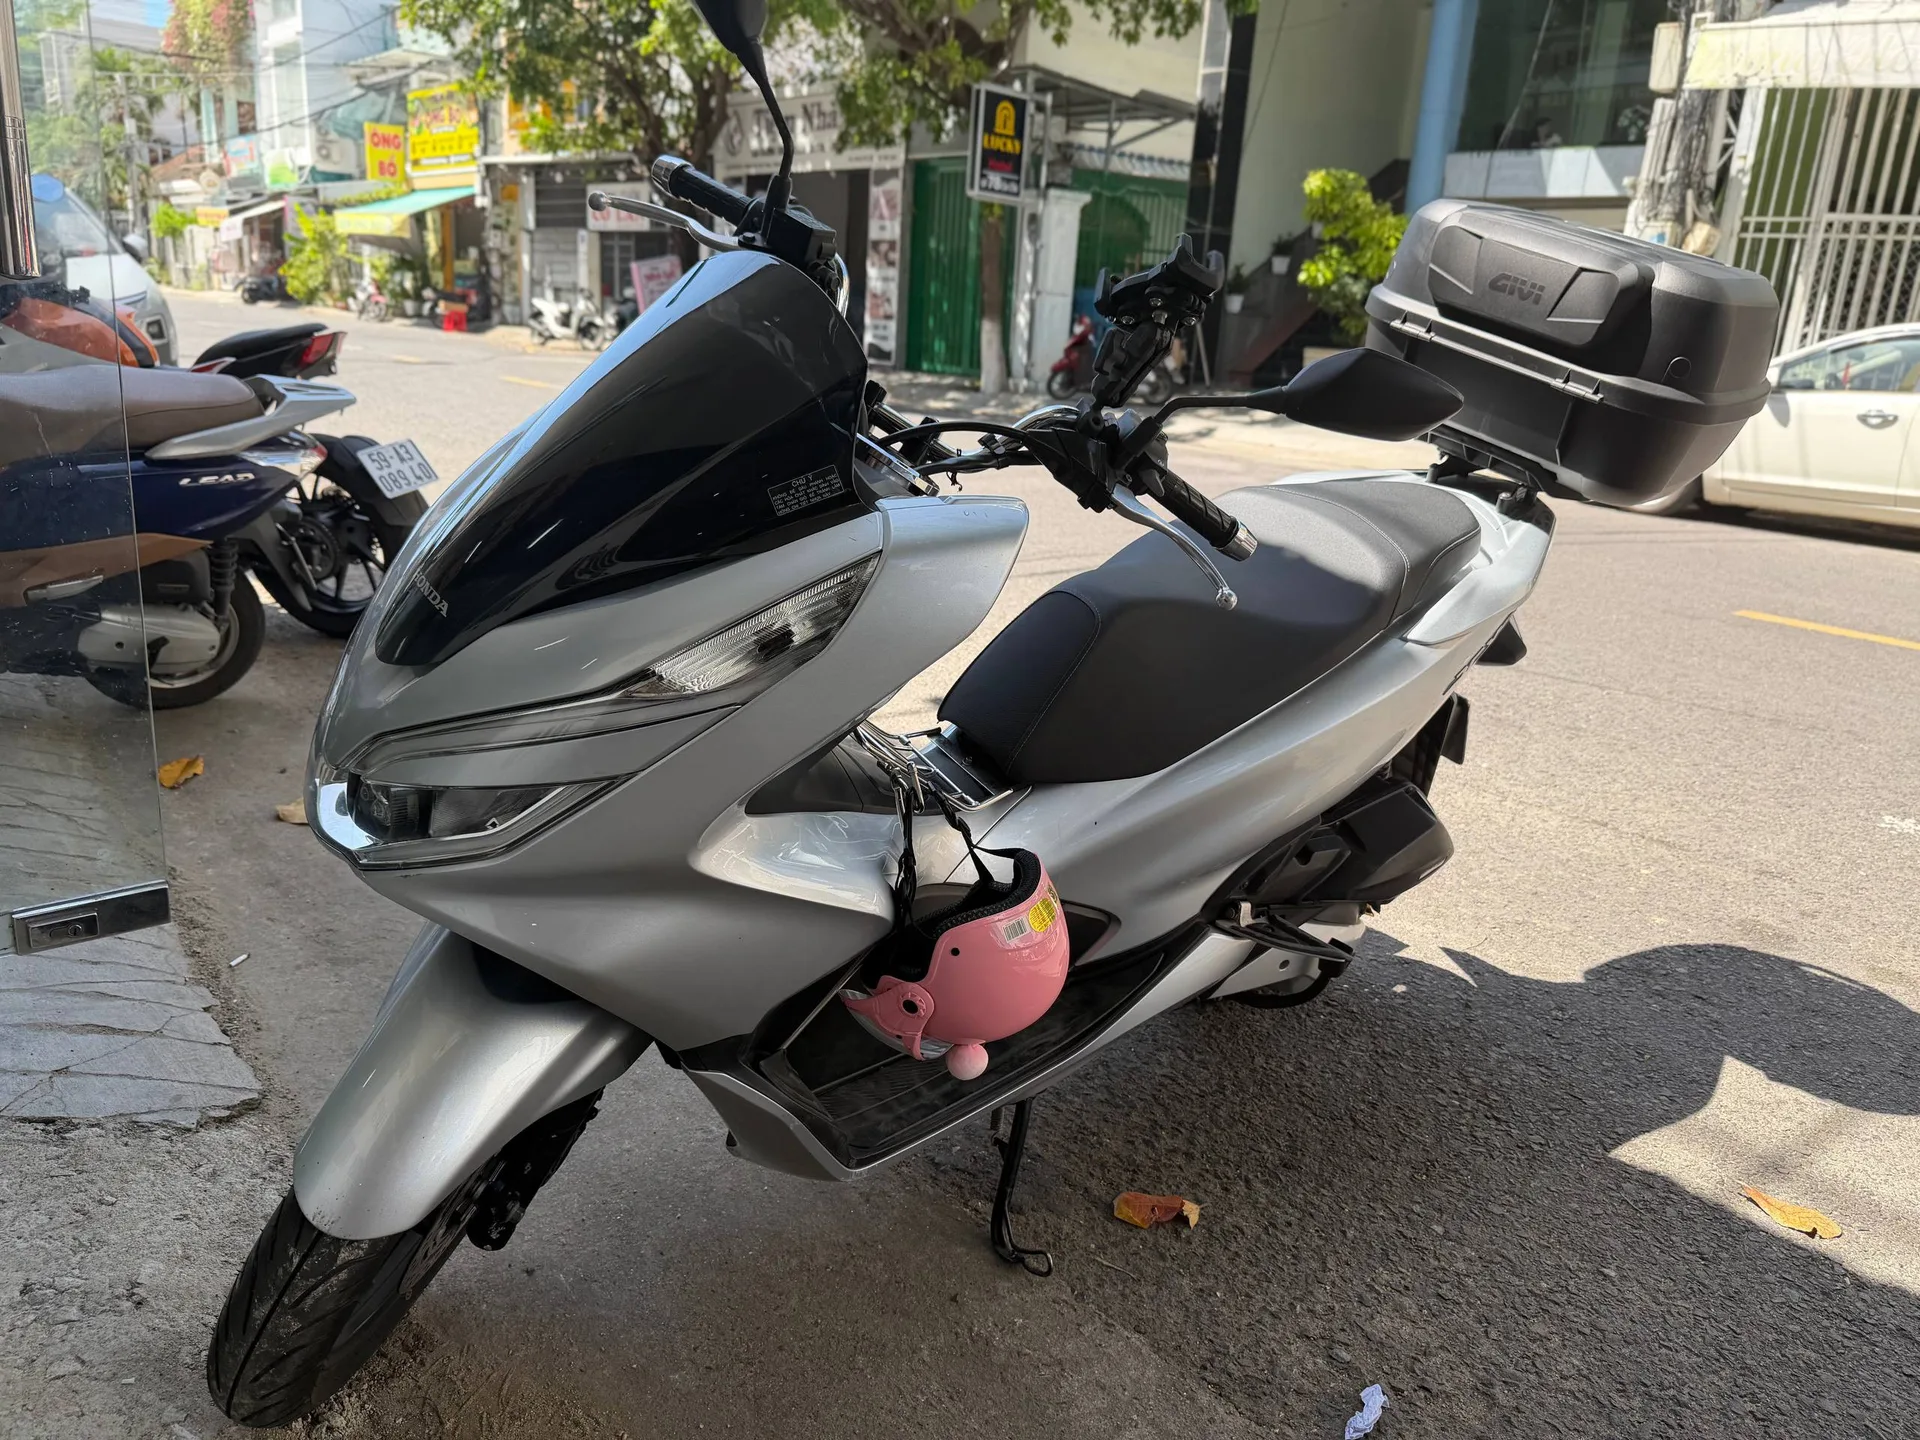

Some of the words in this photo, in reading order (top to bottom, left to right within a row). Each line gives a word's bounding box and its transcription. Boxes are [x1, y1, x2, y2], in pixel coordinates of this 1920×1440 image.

[983, 132, 1021, 155] LUCKY
[1488, 272, 1546, 306] GIVI
[179, 472, 256, 487] LEAD
[378, 462, 432, 492] 089.40
